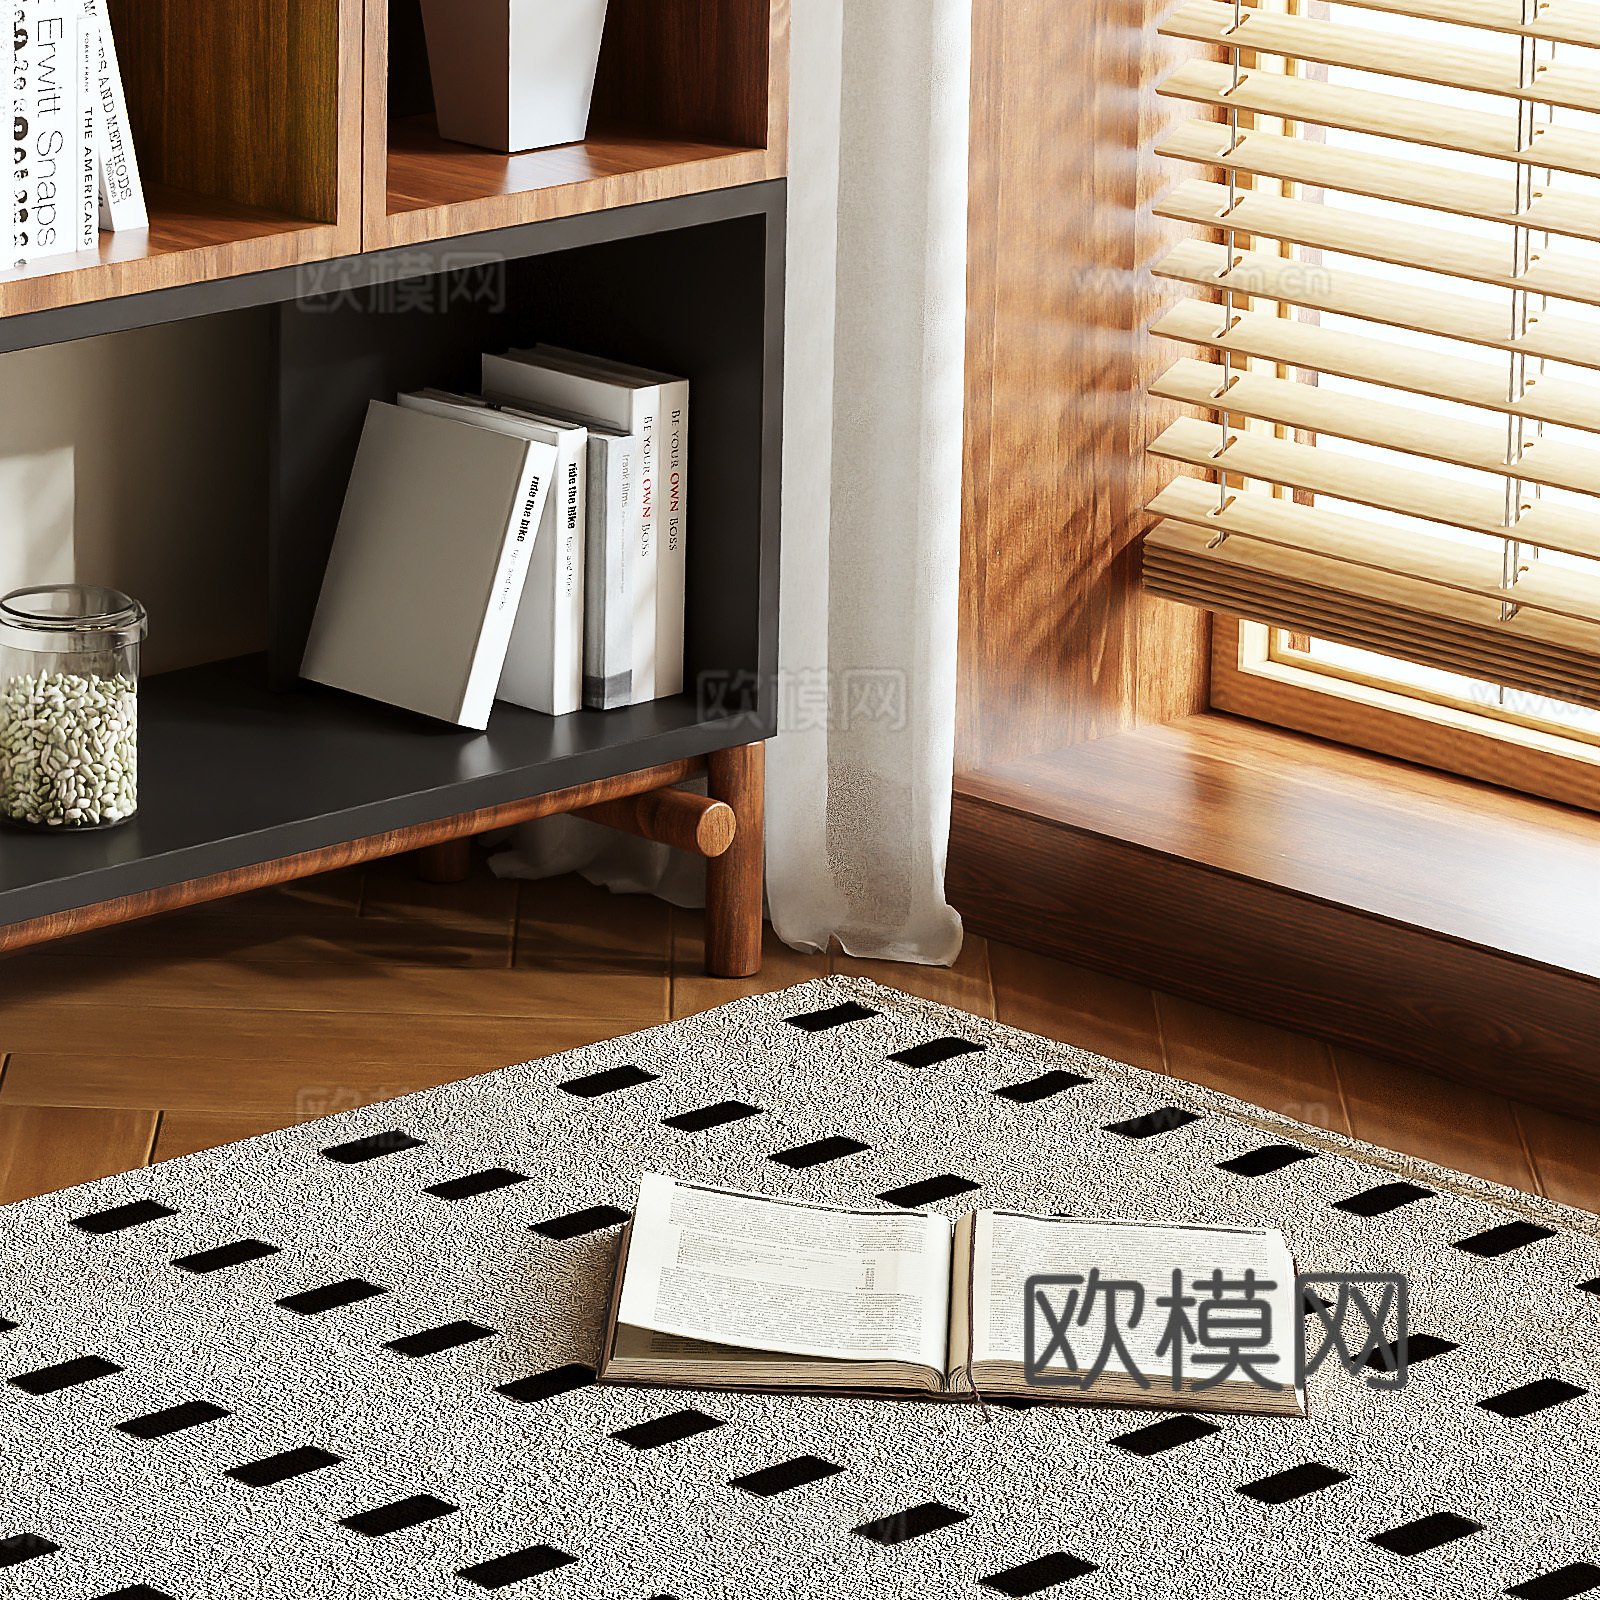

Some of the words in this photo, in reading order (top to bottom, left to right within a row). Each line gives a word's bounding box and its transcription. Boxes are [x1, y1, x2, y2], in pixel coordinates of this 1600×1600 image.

[36, 17, 63, 118] Erwitt
[98, 76, 115, 113] AND
[84, 106, 93, 140] THE
[106, 115, 132, 201] METHODS
[31, 130, 64, 247] Snaps
[83, 146, 93, 246] AMERICANS
[643, 416, 653, 432] BE
[671, 409, 681, 426] BE
[642, 435, 652, 476] YOUR
[670, 430, 680, 469] YOUR
[568, 462, 578, 485] ride
[622, 454, 630, 480] frank
[528, 475, 540, 498] ride
[567, 485, 577, 504] the
[621, 481, 630, 509] films
[642, 478, 651, 518] OWN
[669, 472, 680, 512] OWN
[516, 518, 531, 543] bike
[567, 505, 577, 530] bike
[668, 517, 679, 551] BOSS
[641, 523, 650, 557] BOSS
